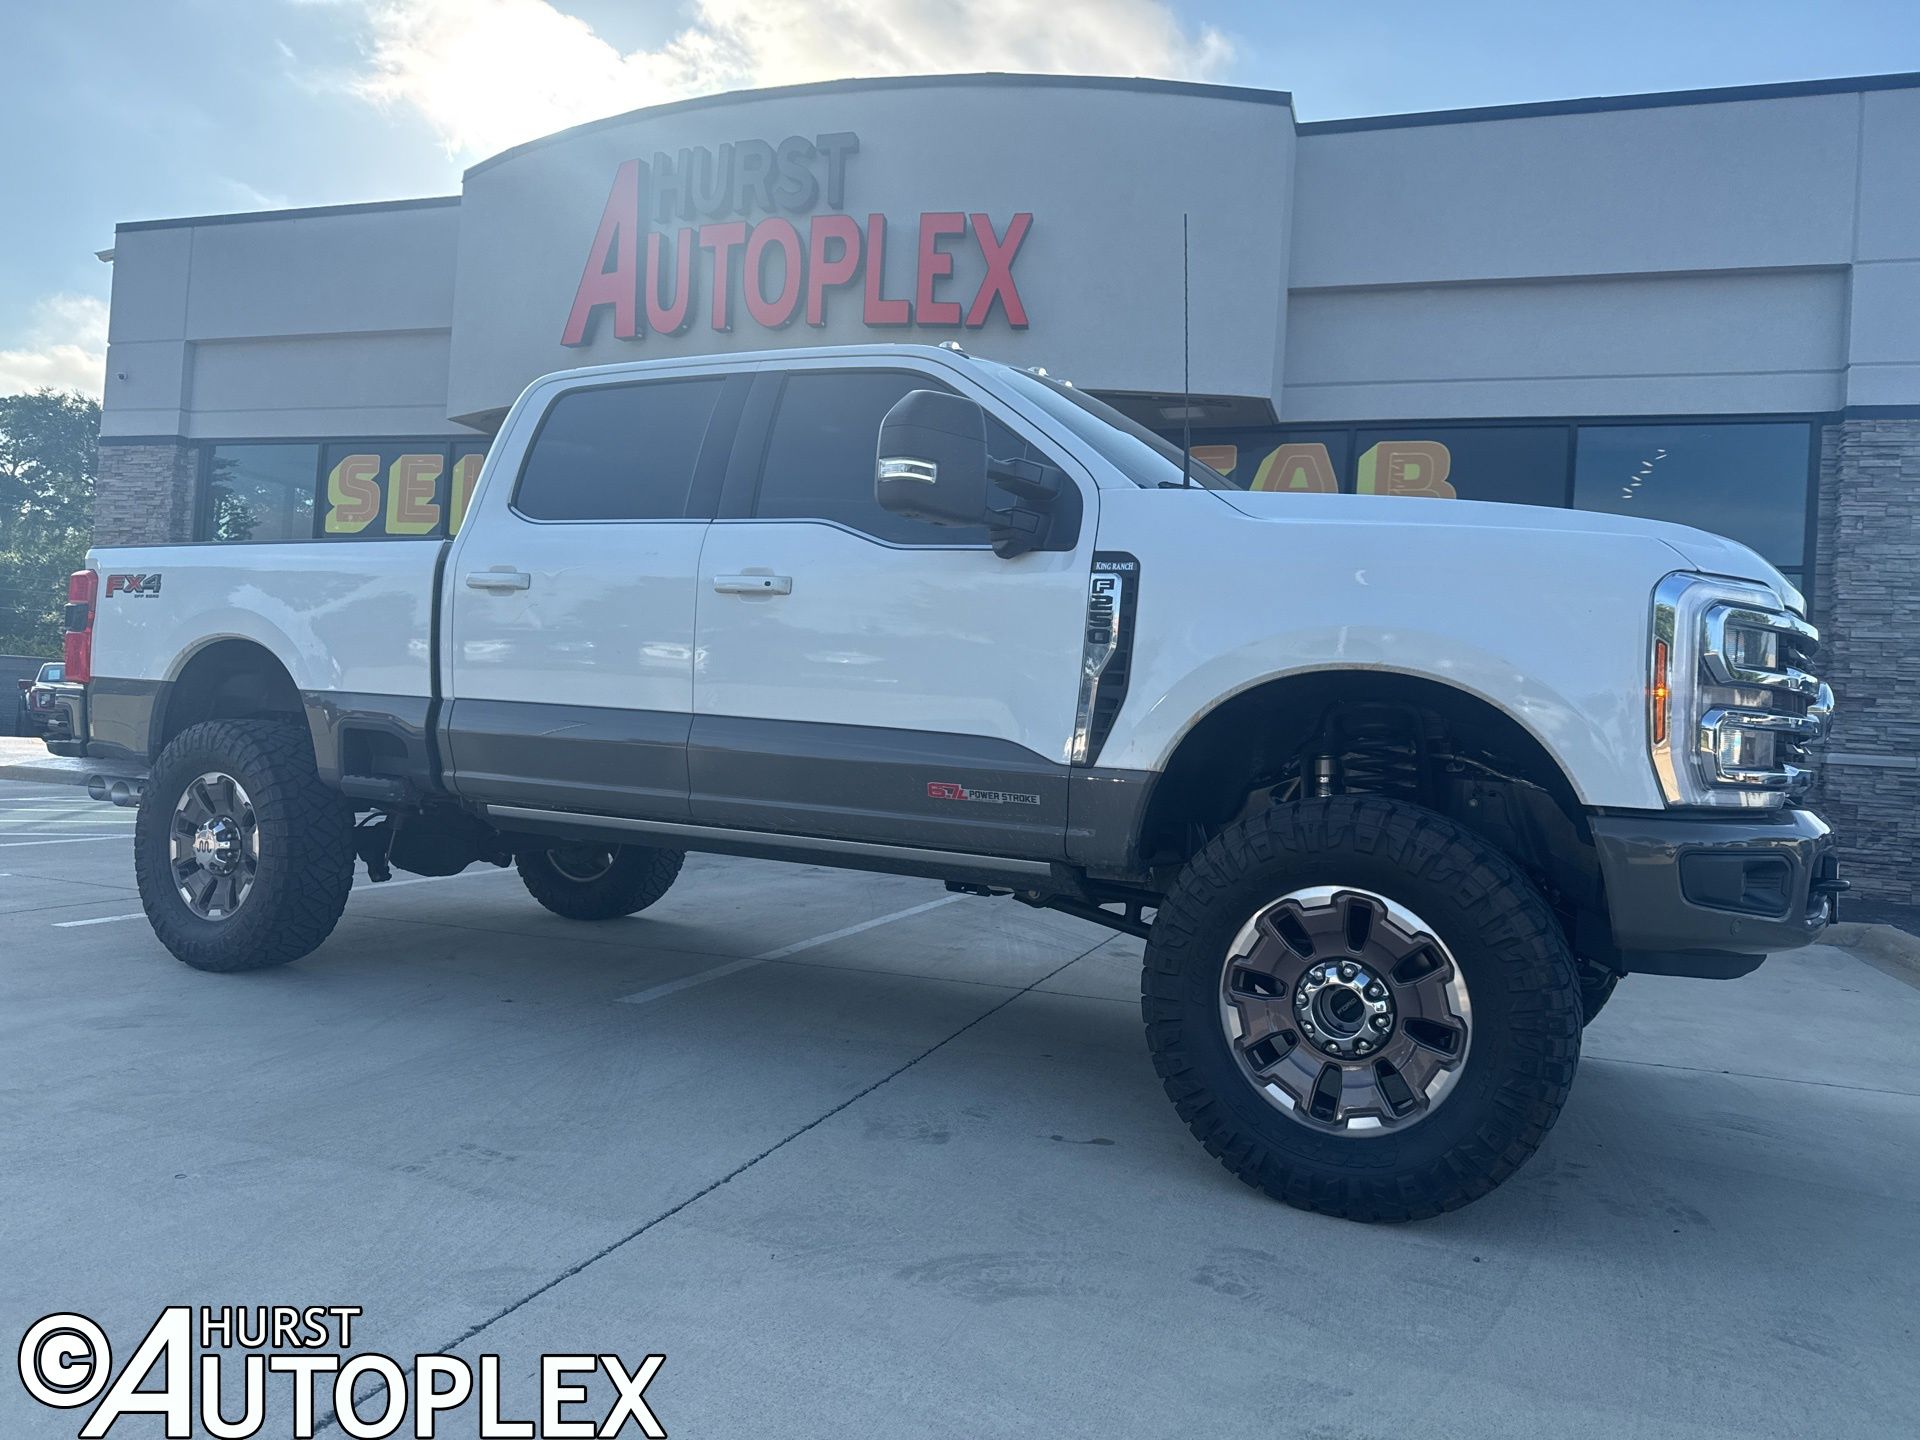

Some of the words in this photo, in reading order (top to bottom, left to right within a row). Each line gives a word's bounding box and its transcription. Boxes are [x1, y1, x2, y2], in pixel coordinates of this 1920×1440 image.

[653, 131, 860, 221] HURST
[561, 159, 1034, 347] AUTOPLEX
[1095, 562, 1112, 571] KING
[1112, 562, 1134, 571] RANCH
[106, 574, 162, 598] FX4
[969, 790, 1000, 801] POWER
[1001, 793, 1038, 803] STROKE
